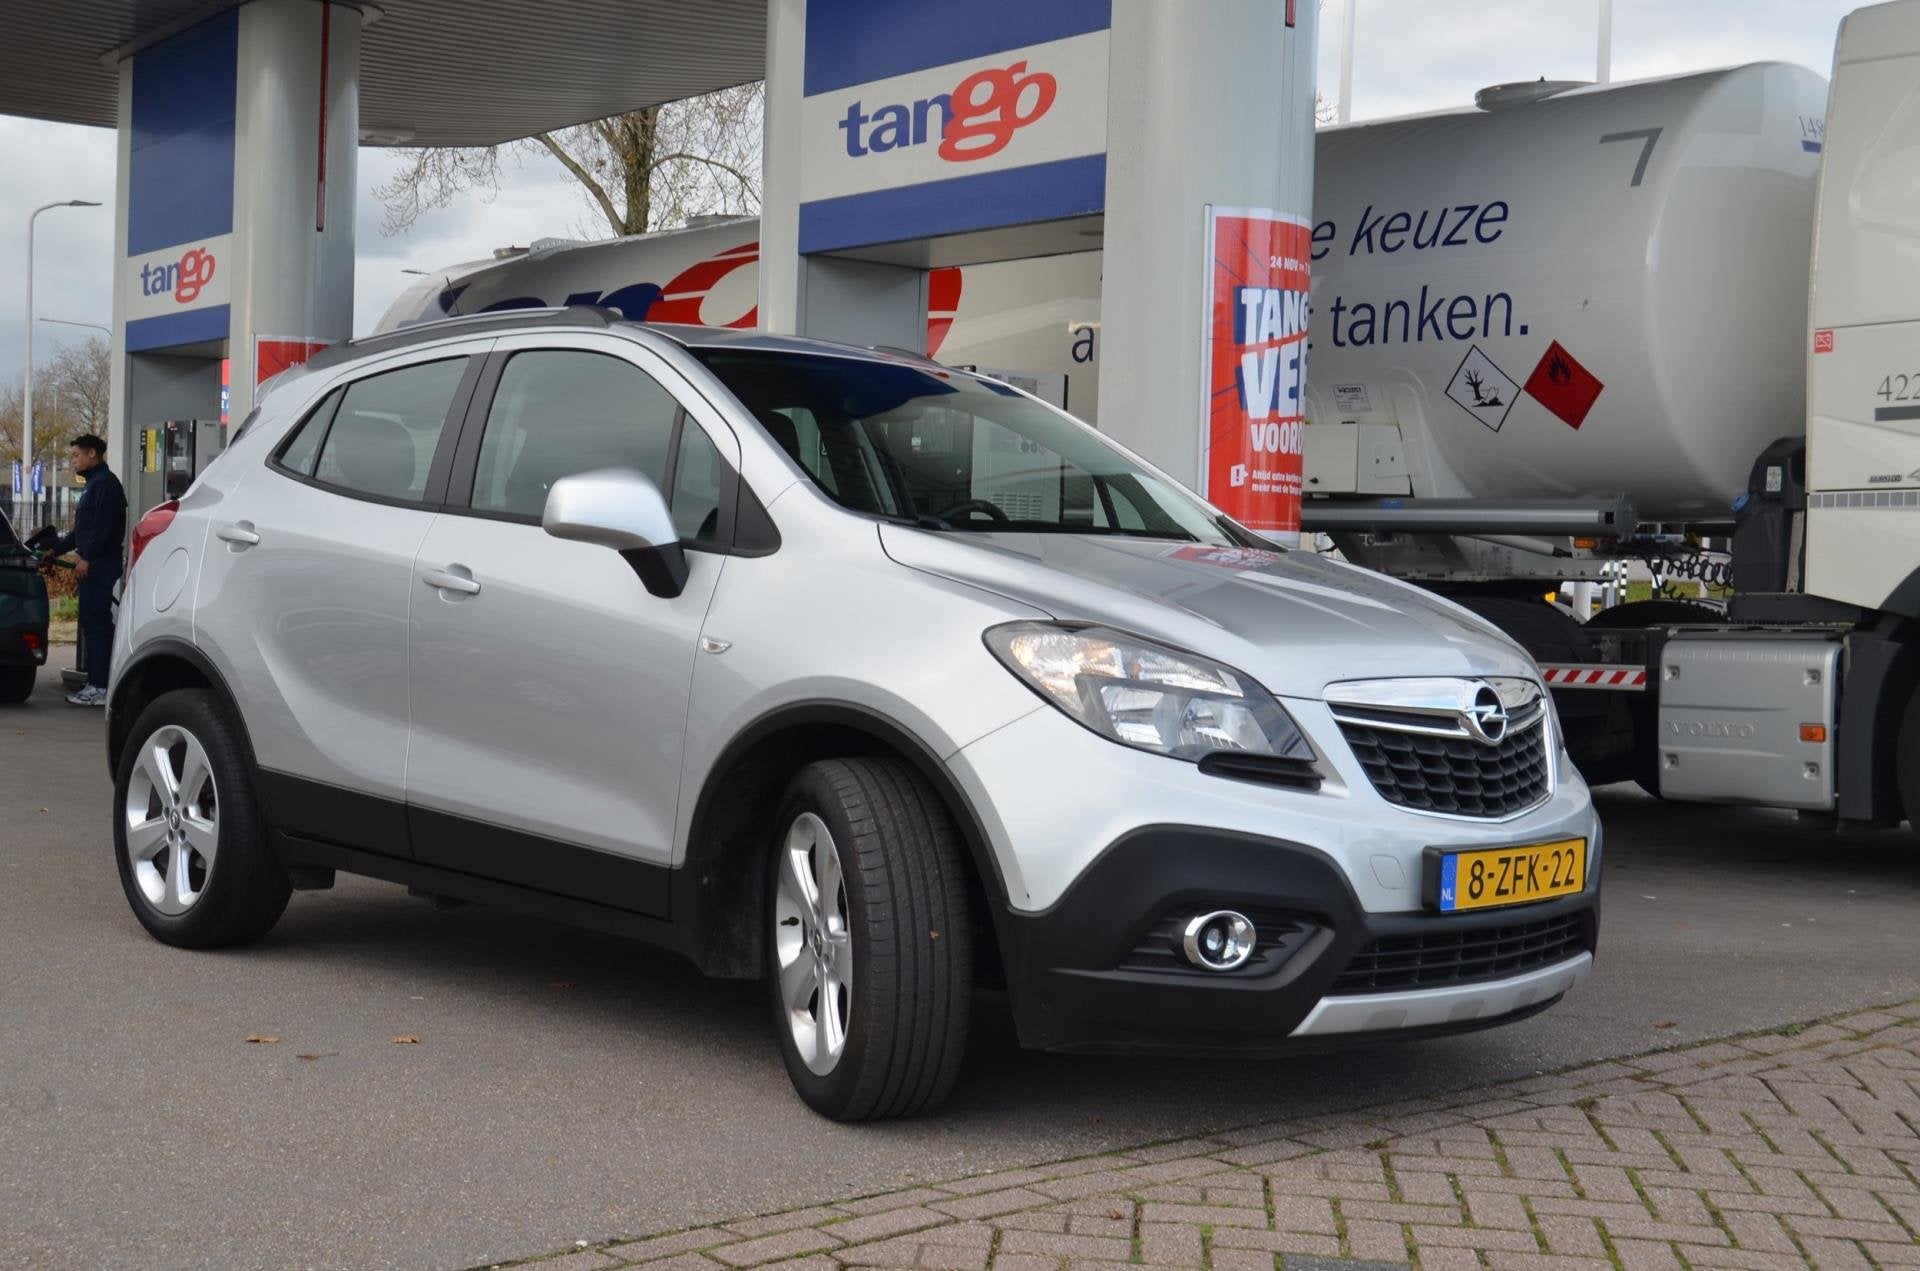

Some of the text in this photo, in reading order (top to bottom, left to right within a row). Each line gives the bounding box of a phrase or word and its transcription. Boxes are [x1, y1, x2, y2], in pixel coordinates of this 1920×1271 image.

[838, 60, 1057, 163] tango
[1598, 127, 1664, 187] 7
[1349, 200, 1509, 256] keuze
[140, 246, 216, 304] tango
[1270, 256, 1282, 269] 24
[1284, 256, 1299, 271] NOV
[1330, 285, 1529, 347] tanken.
[1441, 887, 1454, 900] NL
[1468, 848, 1576, 900] 8-ZFK-22
